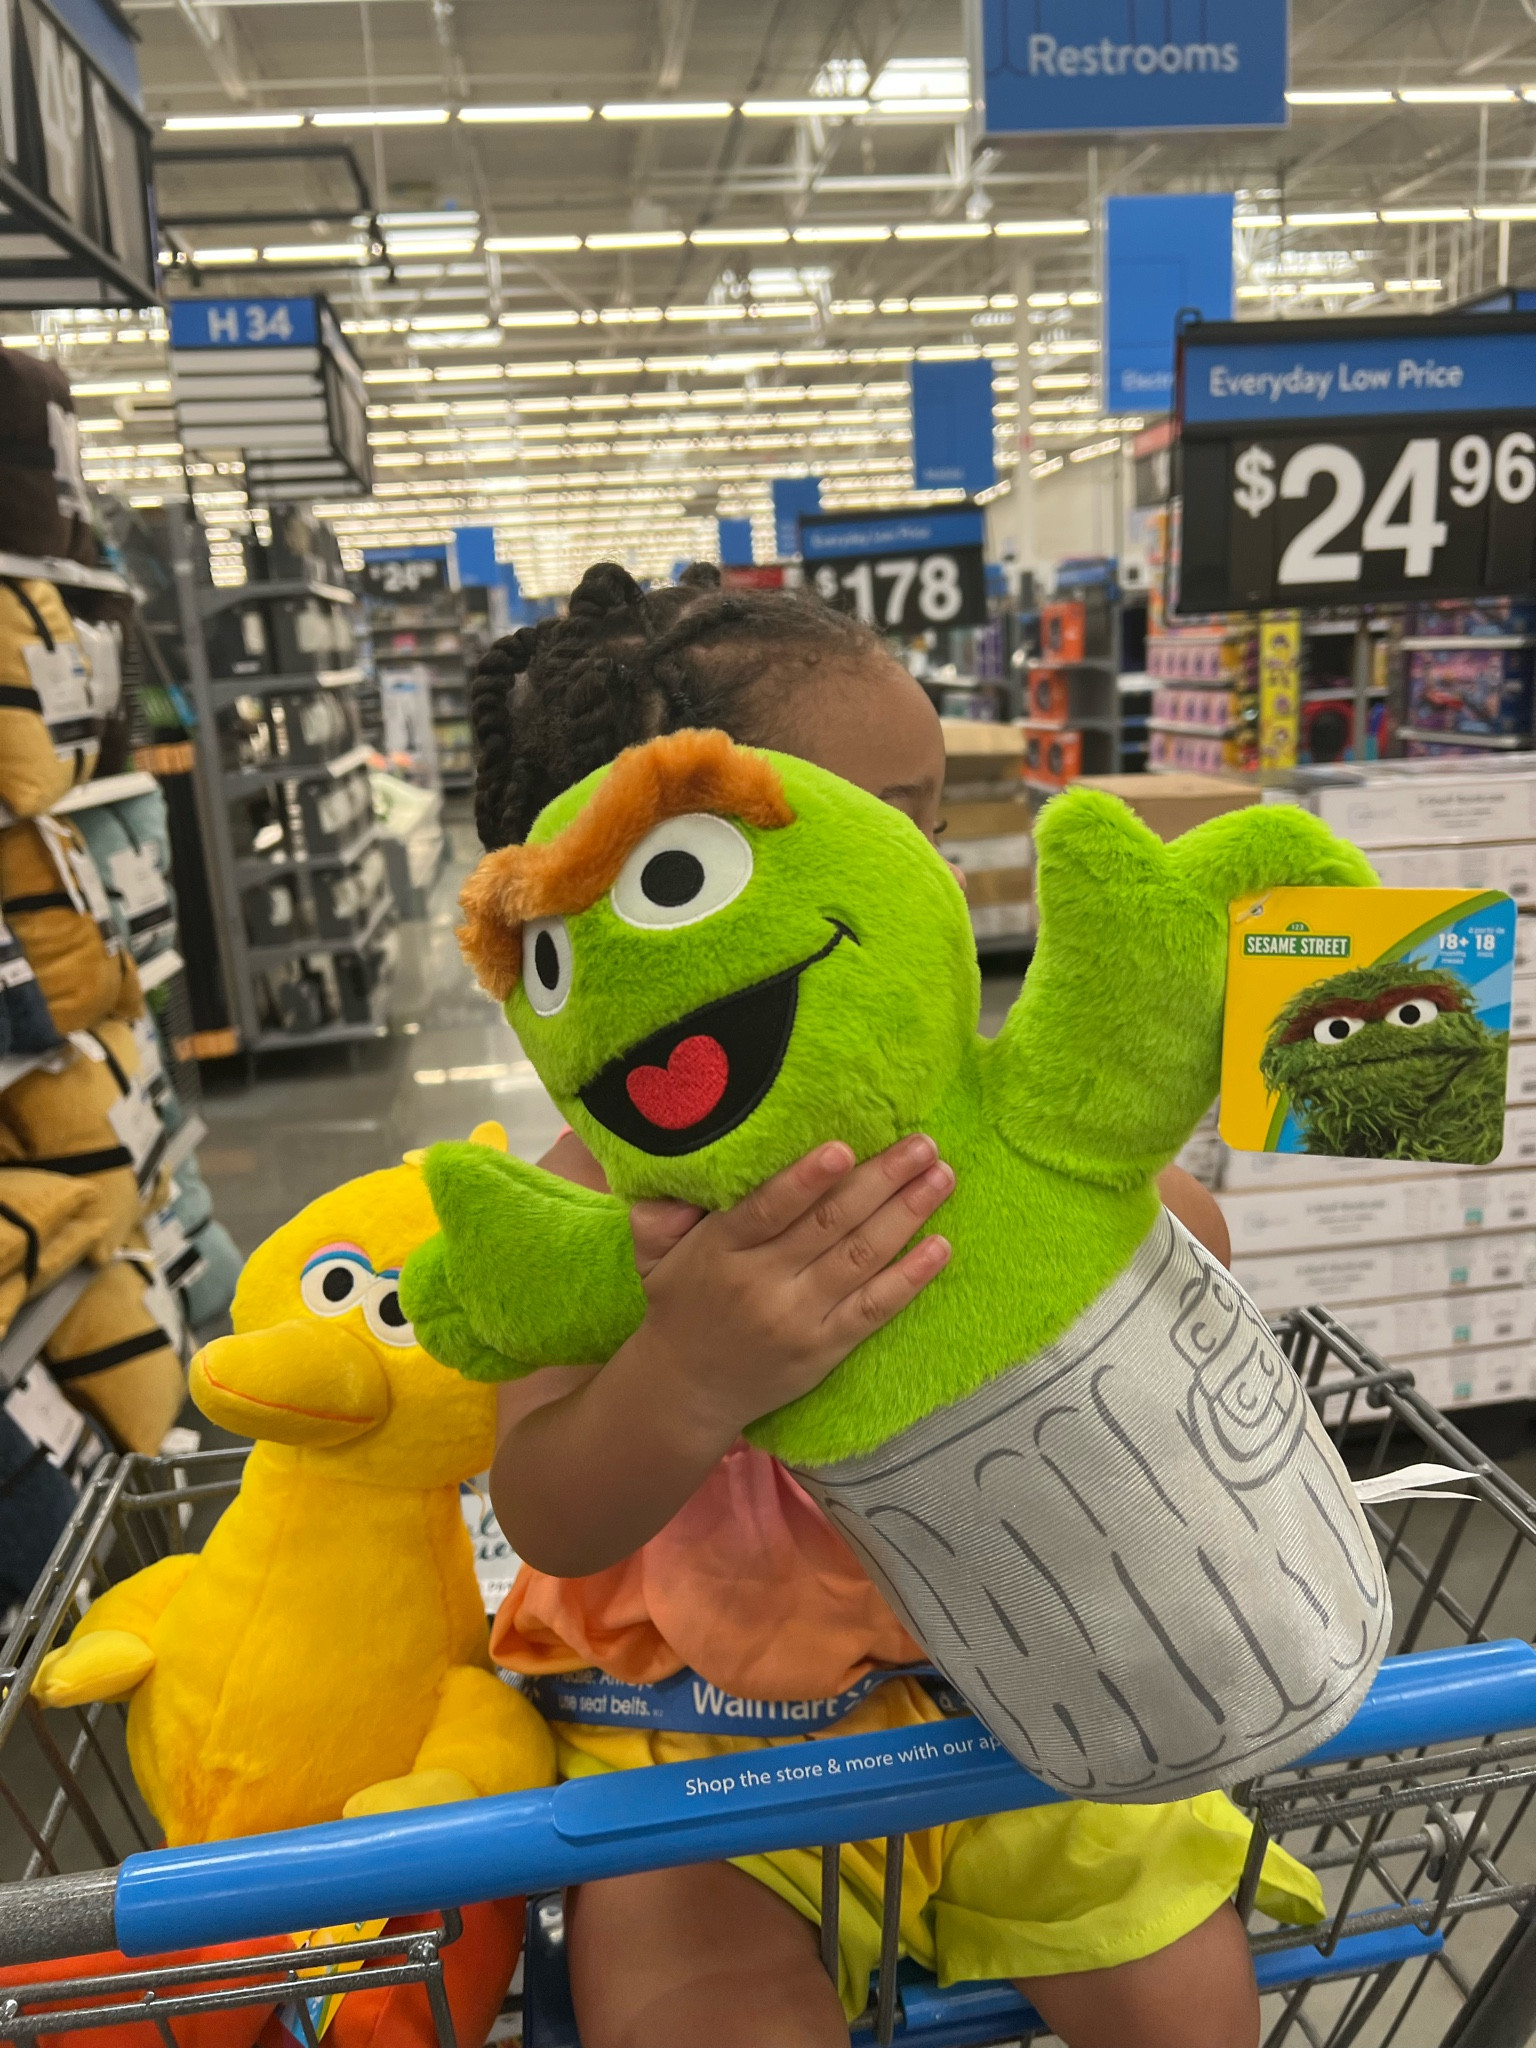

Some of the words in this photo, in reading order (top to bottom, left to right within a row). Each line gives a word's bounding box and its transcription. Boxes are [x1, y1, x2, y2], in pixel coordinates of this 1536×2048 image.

[1028, 33, 1239, 77] Restrooms
[207, 307, 240, 343] H
[245, 304, 293, 342] 34
[1209, 362, 1334, 402] Everyday
[1338, 361, 1393, 392] Low
[1398, 357, 1464, 389] Price
[1247, 936, 1297, 954] SESAME
[1300, 937, 1348, 955] STREET
[1439, 932, 1469, 950] 18+
[1475, 934, 1495, 951] 18
[579, 1694, 607, 1713] seat
[611, 1695, 651, 1717] belts.
[685, 1777, 735, 1795] Shop
[739, 1770, 771, 1787] the
[776, 1764, 823, 1782] store
[827, 1758, 841, 1774] &
[845, 1753, 894, 1771] more
[898, 1742, 938, 1763] with
[943, 1739, 973, 1755] our
